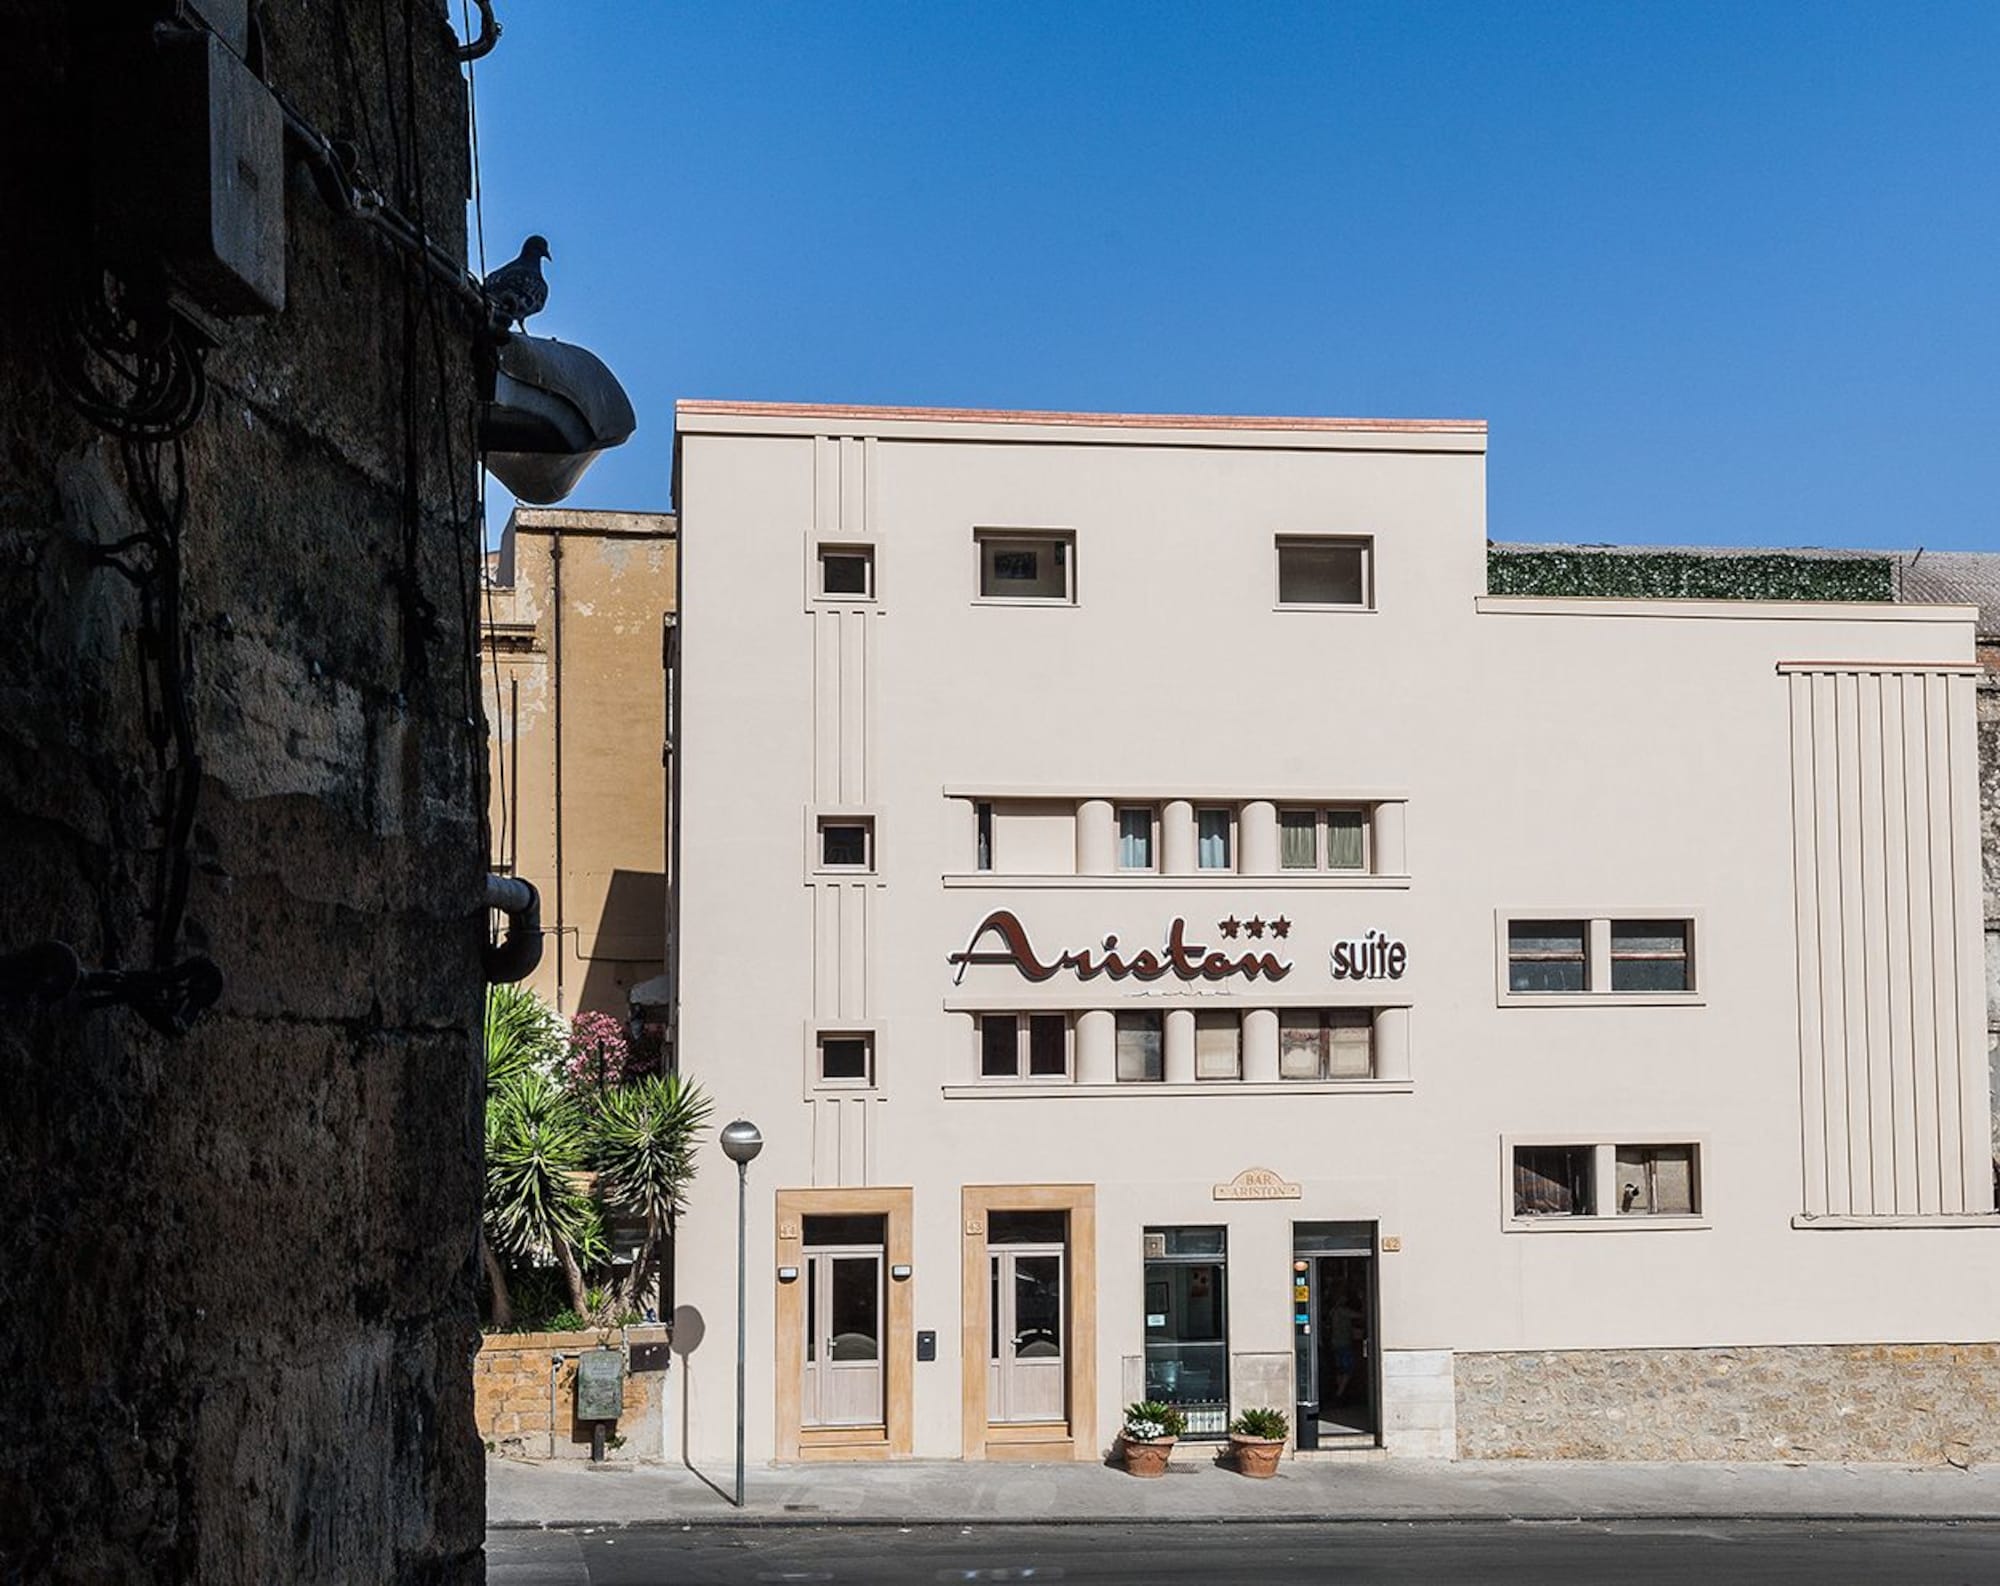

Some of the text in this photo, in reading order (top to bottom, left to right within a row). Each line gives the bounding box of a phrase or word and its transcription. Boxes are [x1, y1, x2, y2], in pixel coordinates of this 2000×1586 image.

[948, 909, 1407, 986] Ariston suite
[1245, 1174, 1273, 1186] BAR
[1232, 1186, 1286, 1197] ARISTON
